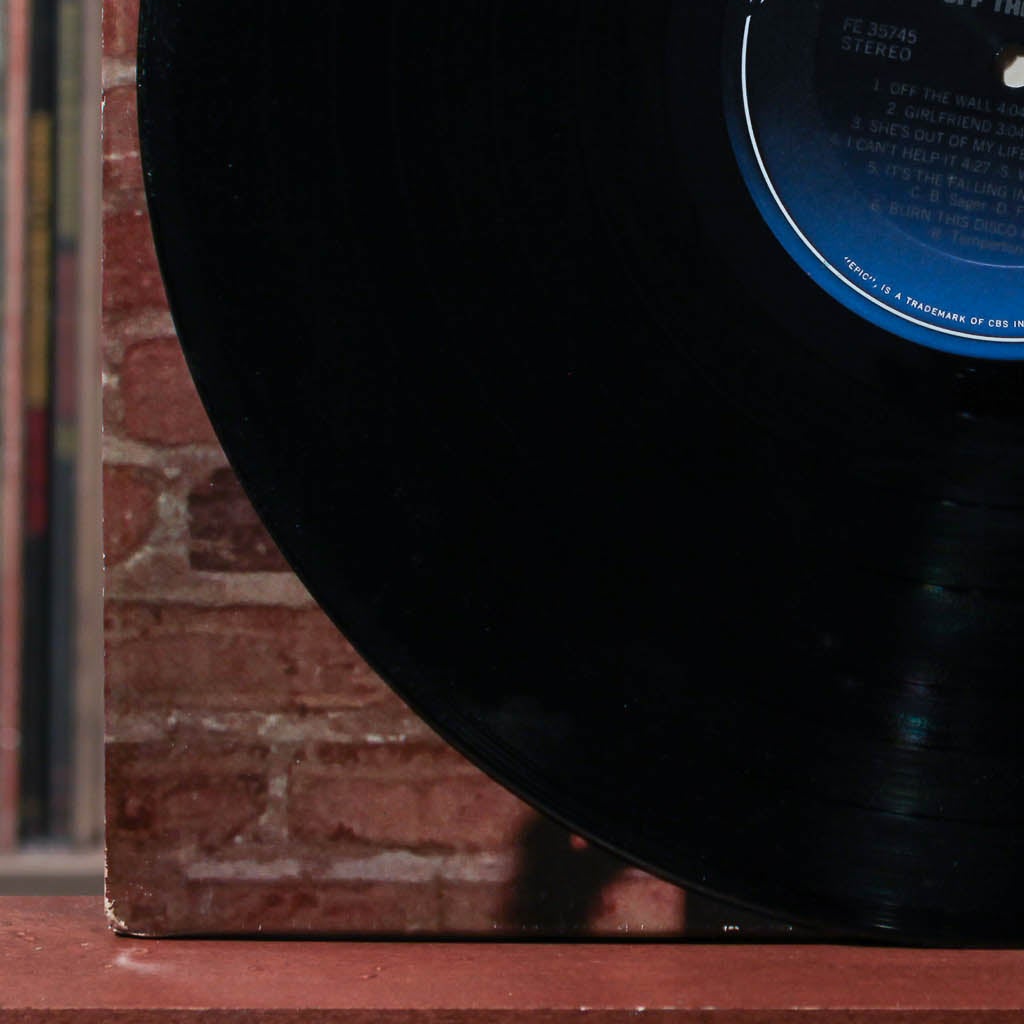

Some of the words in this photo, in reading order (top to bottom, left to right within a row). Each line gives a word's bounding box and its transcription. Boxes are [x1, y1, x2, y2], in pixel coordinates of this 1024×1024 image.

[842, 16, 864, 35] FE
[867, 21, 921, 45] 35745
[840, 35, 912, 62] STEREO
[889, 81, 919, 97] OFF
[922, 86, 951, 105] THE
[955, 94, 992, 113] WALL
[903, 104, 993, 133] GIRLFRIEND
[902, 145, 940, 165] HELP
[914, 127, 945, 144] OUT
[949, 133, 969, 150] OF
[972, 138, 995, 155] MY
[880, 284, 892, 295] IS
[894, 292, 902, 301] A
[905, 296, 966, 324] TRADEMARK
[970, 316, 984, 326] OF
[988, 319, 1009, 329] CBS
